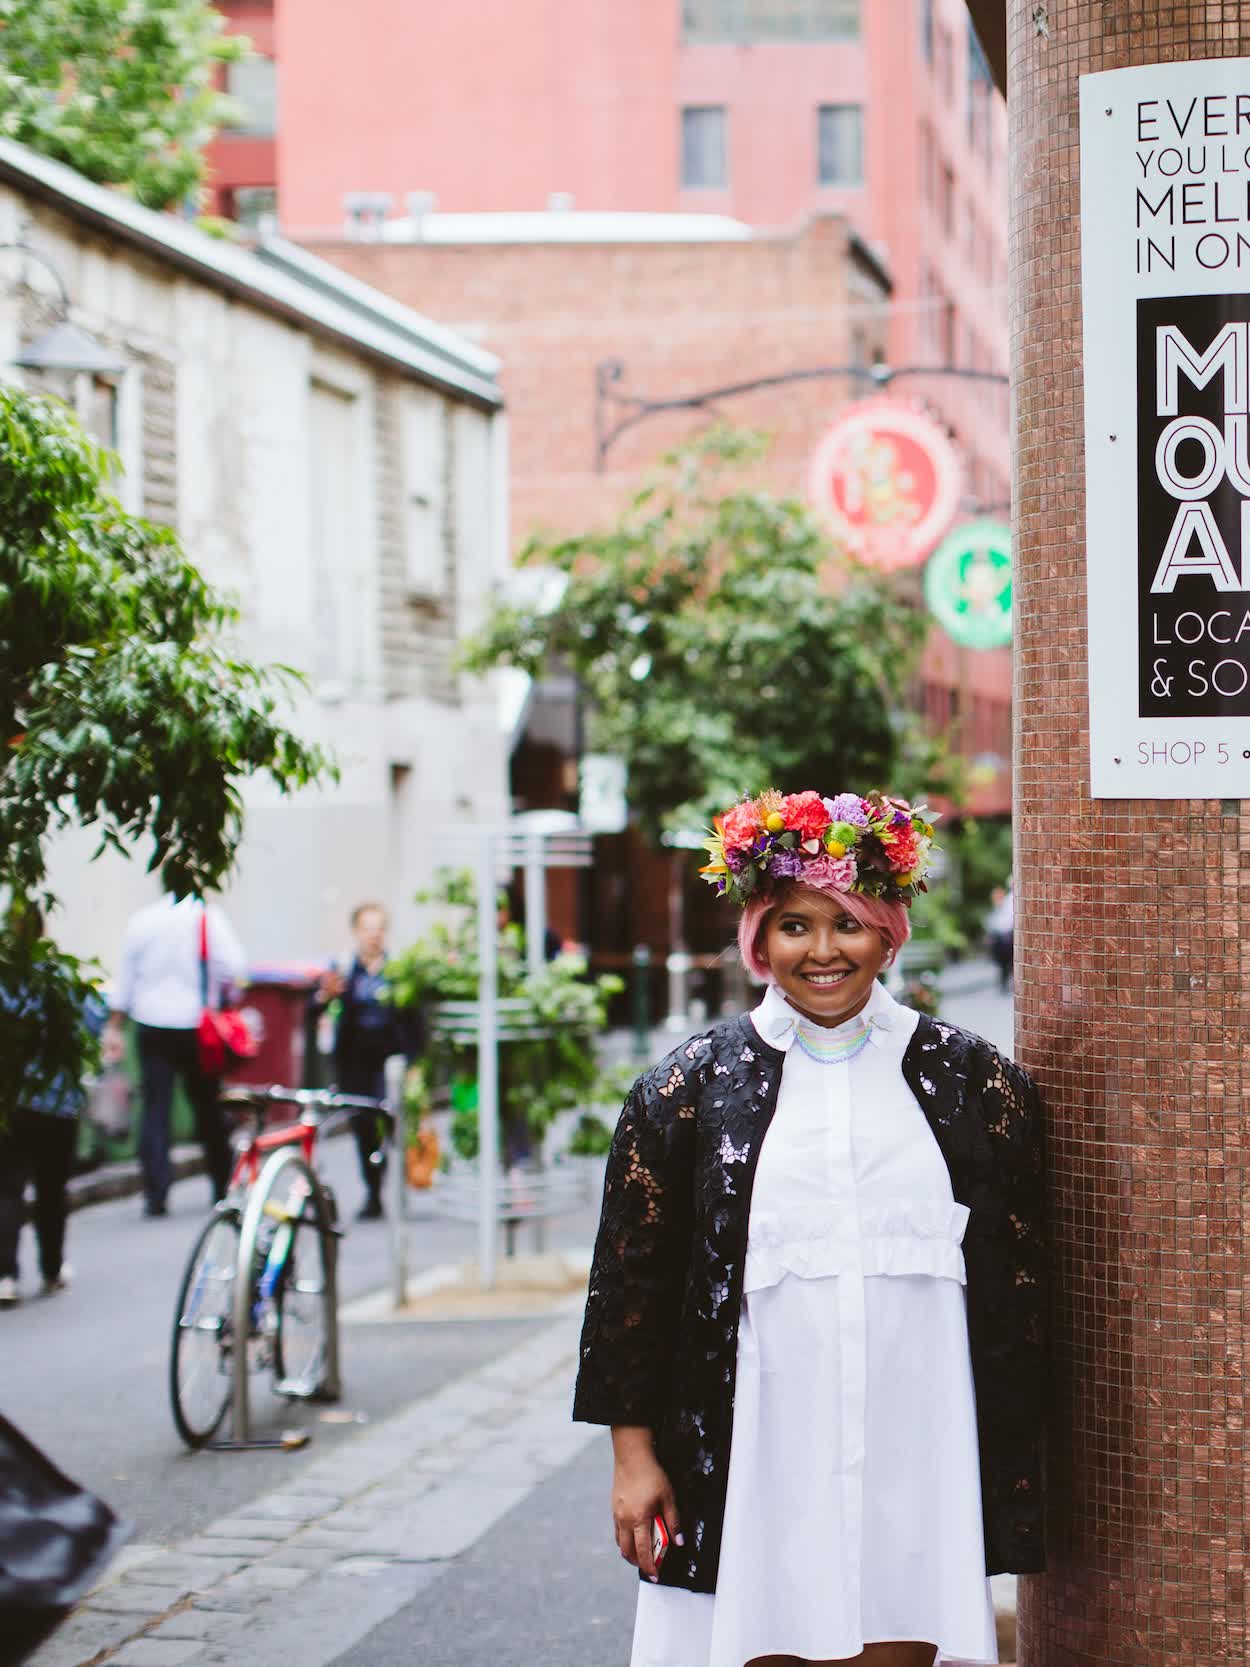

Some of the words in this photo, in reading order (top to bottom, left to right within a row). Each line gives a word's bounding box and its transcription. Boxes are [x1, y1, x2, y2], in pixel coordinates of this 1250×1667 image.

[1136, 146, 1206, 178] YOU
[1136, 235, 1176, 274] IN
[1150, 657, 1174, 697] &
[1137, 741, 1206, 765] SHOP
[1217, 742, 1230, 765] 5
